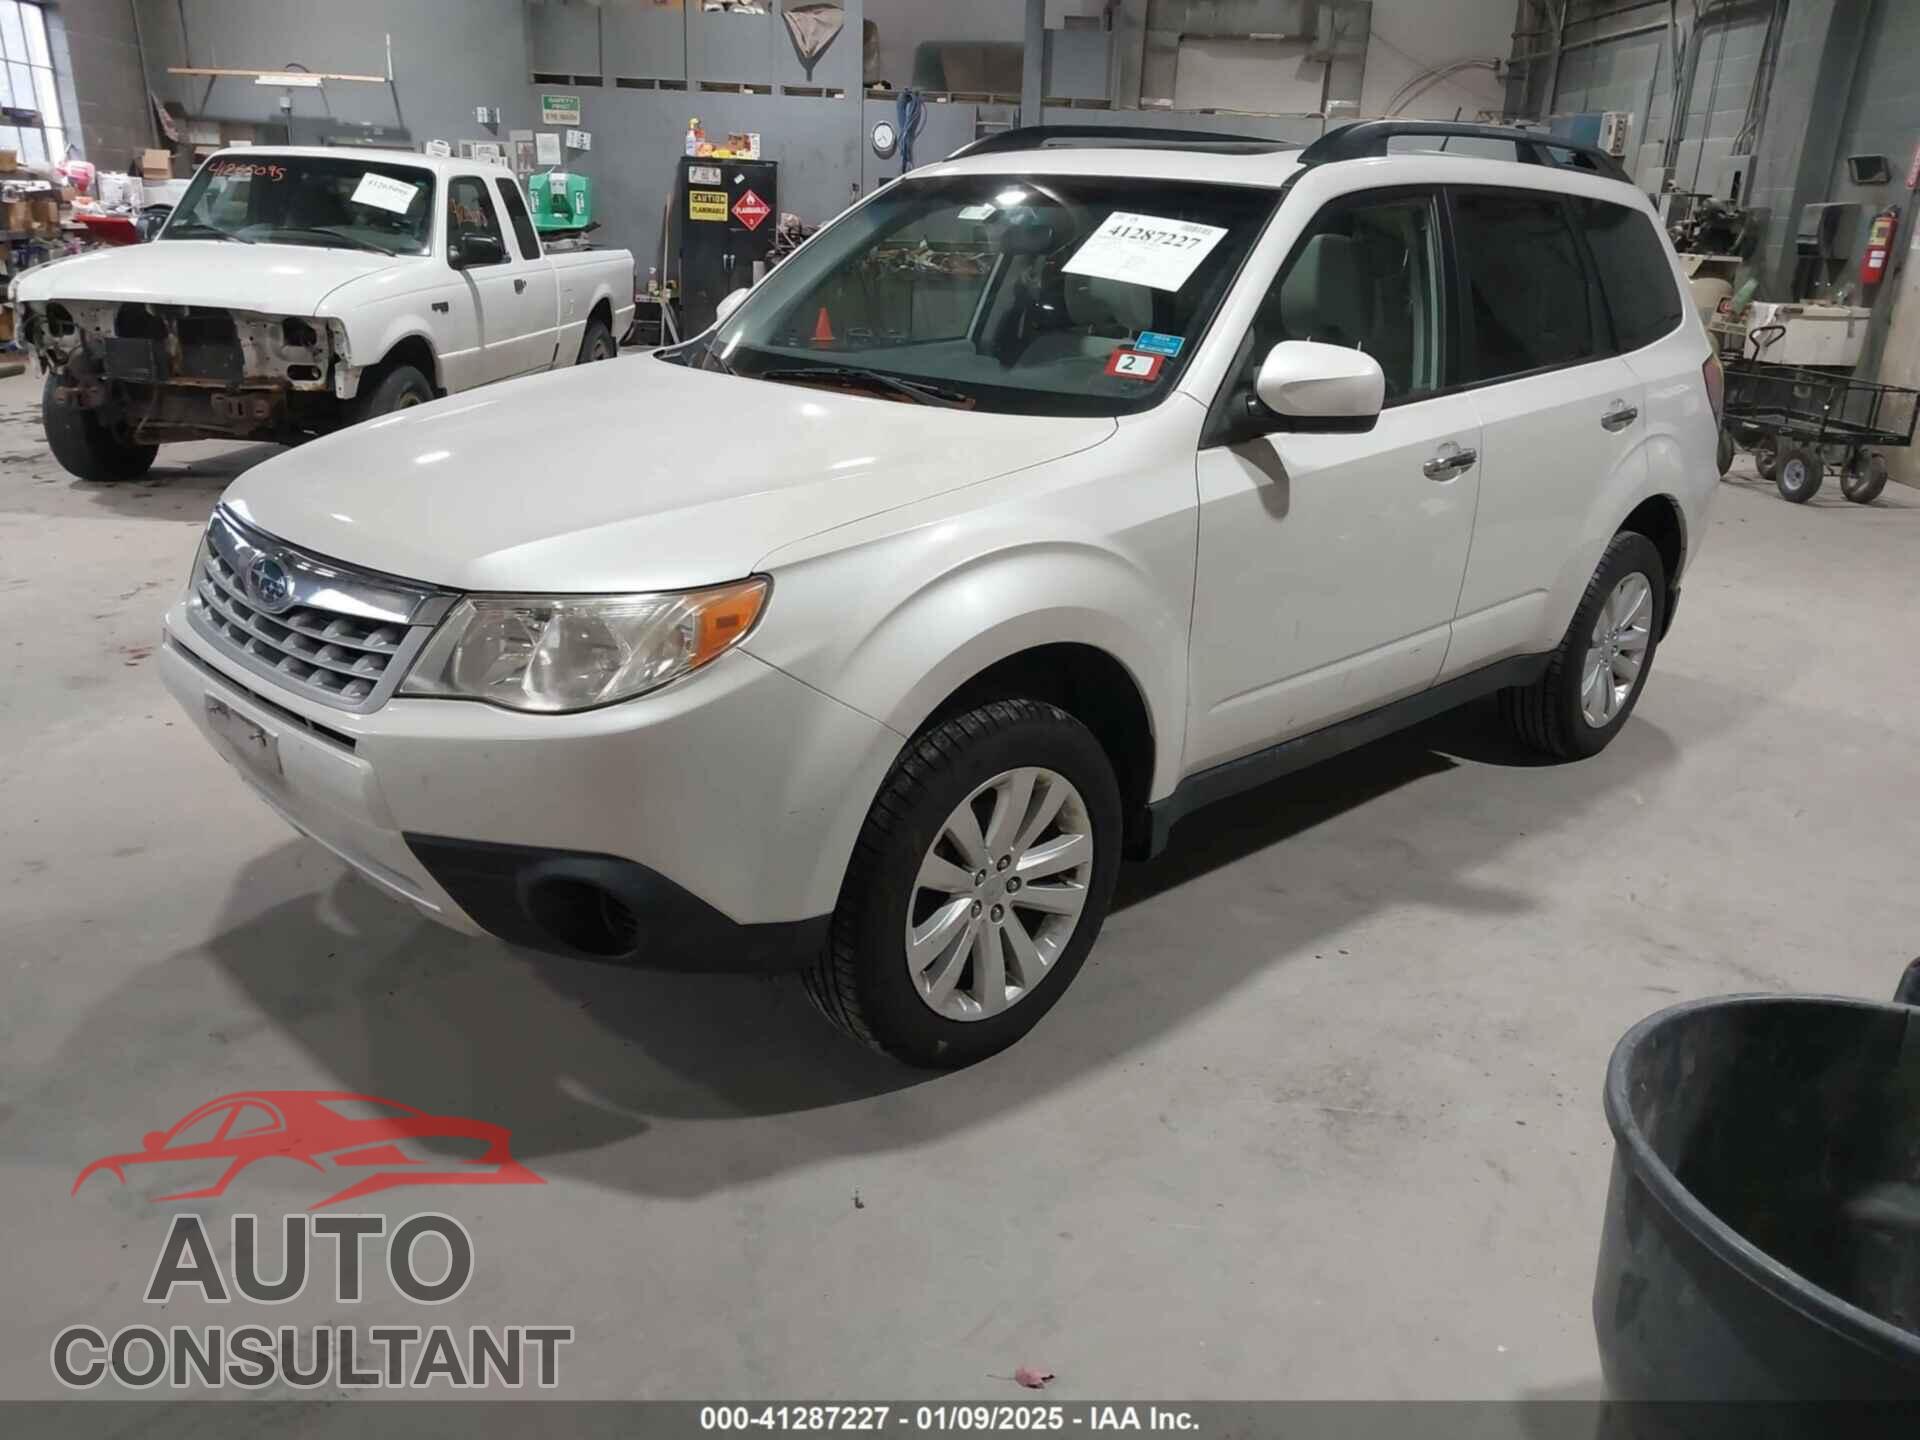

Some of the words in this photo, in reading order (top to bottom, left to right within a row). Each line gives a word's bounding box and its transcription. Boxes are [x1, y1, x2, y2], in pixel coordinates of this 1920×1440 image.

[692, 193, 726, 203] CAUTION
[1108, 224, 1203, 249] 41287227
[1121, 355, 1137, 370] 2
